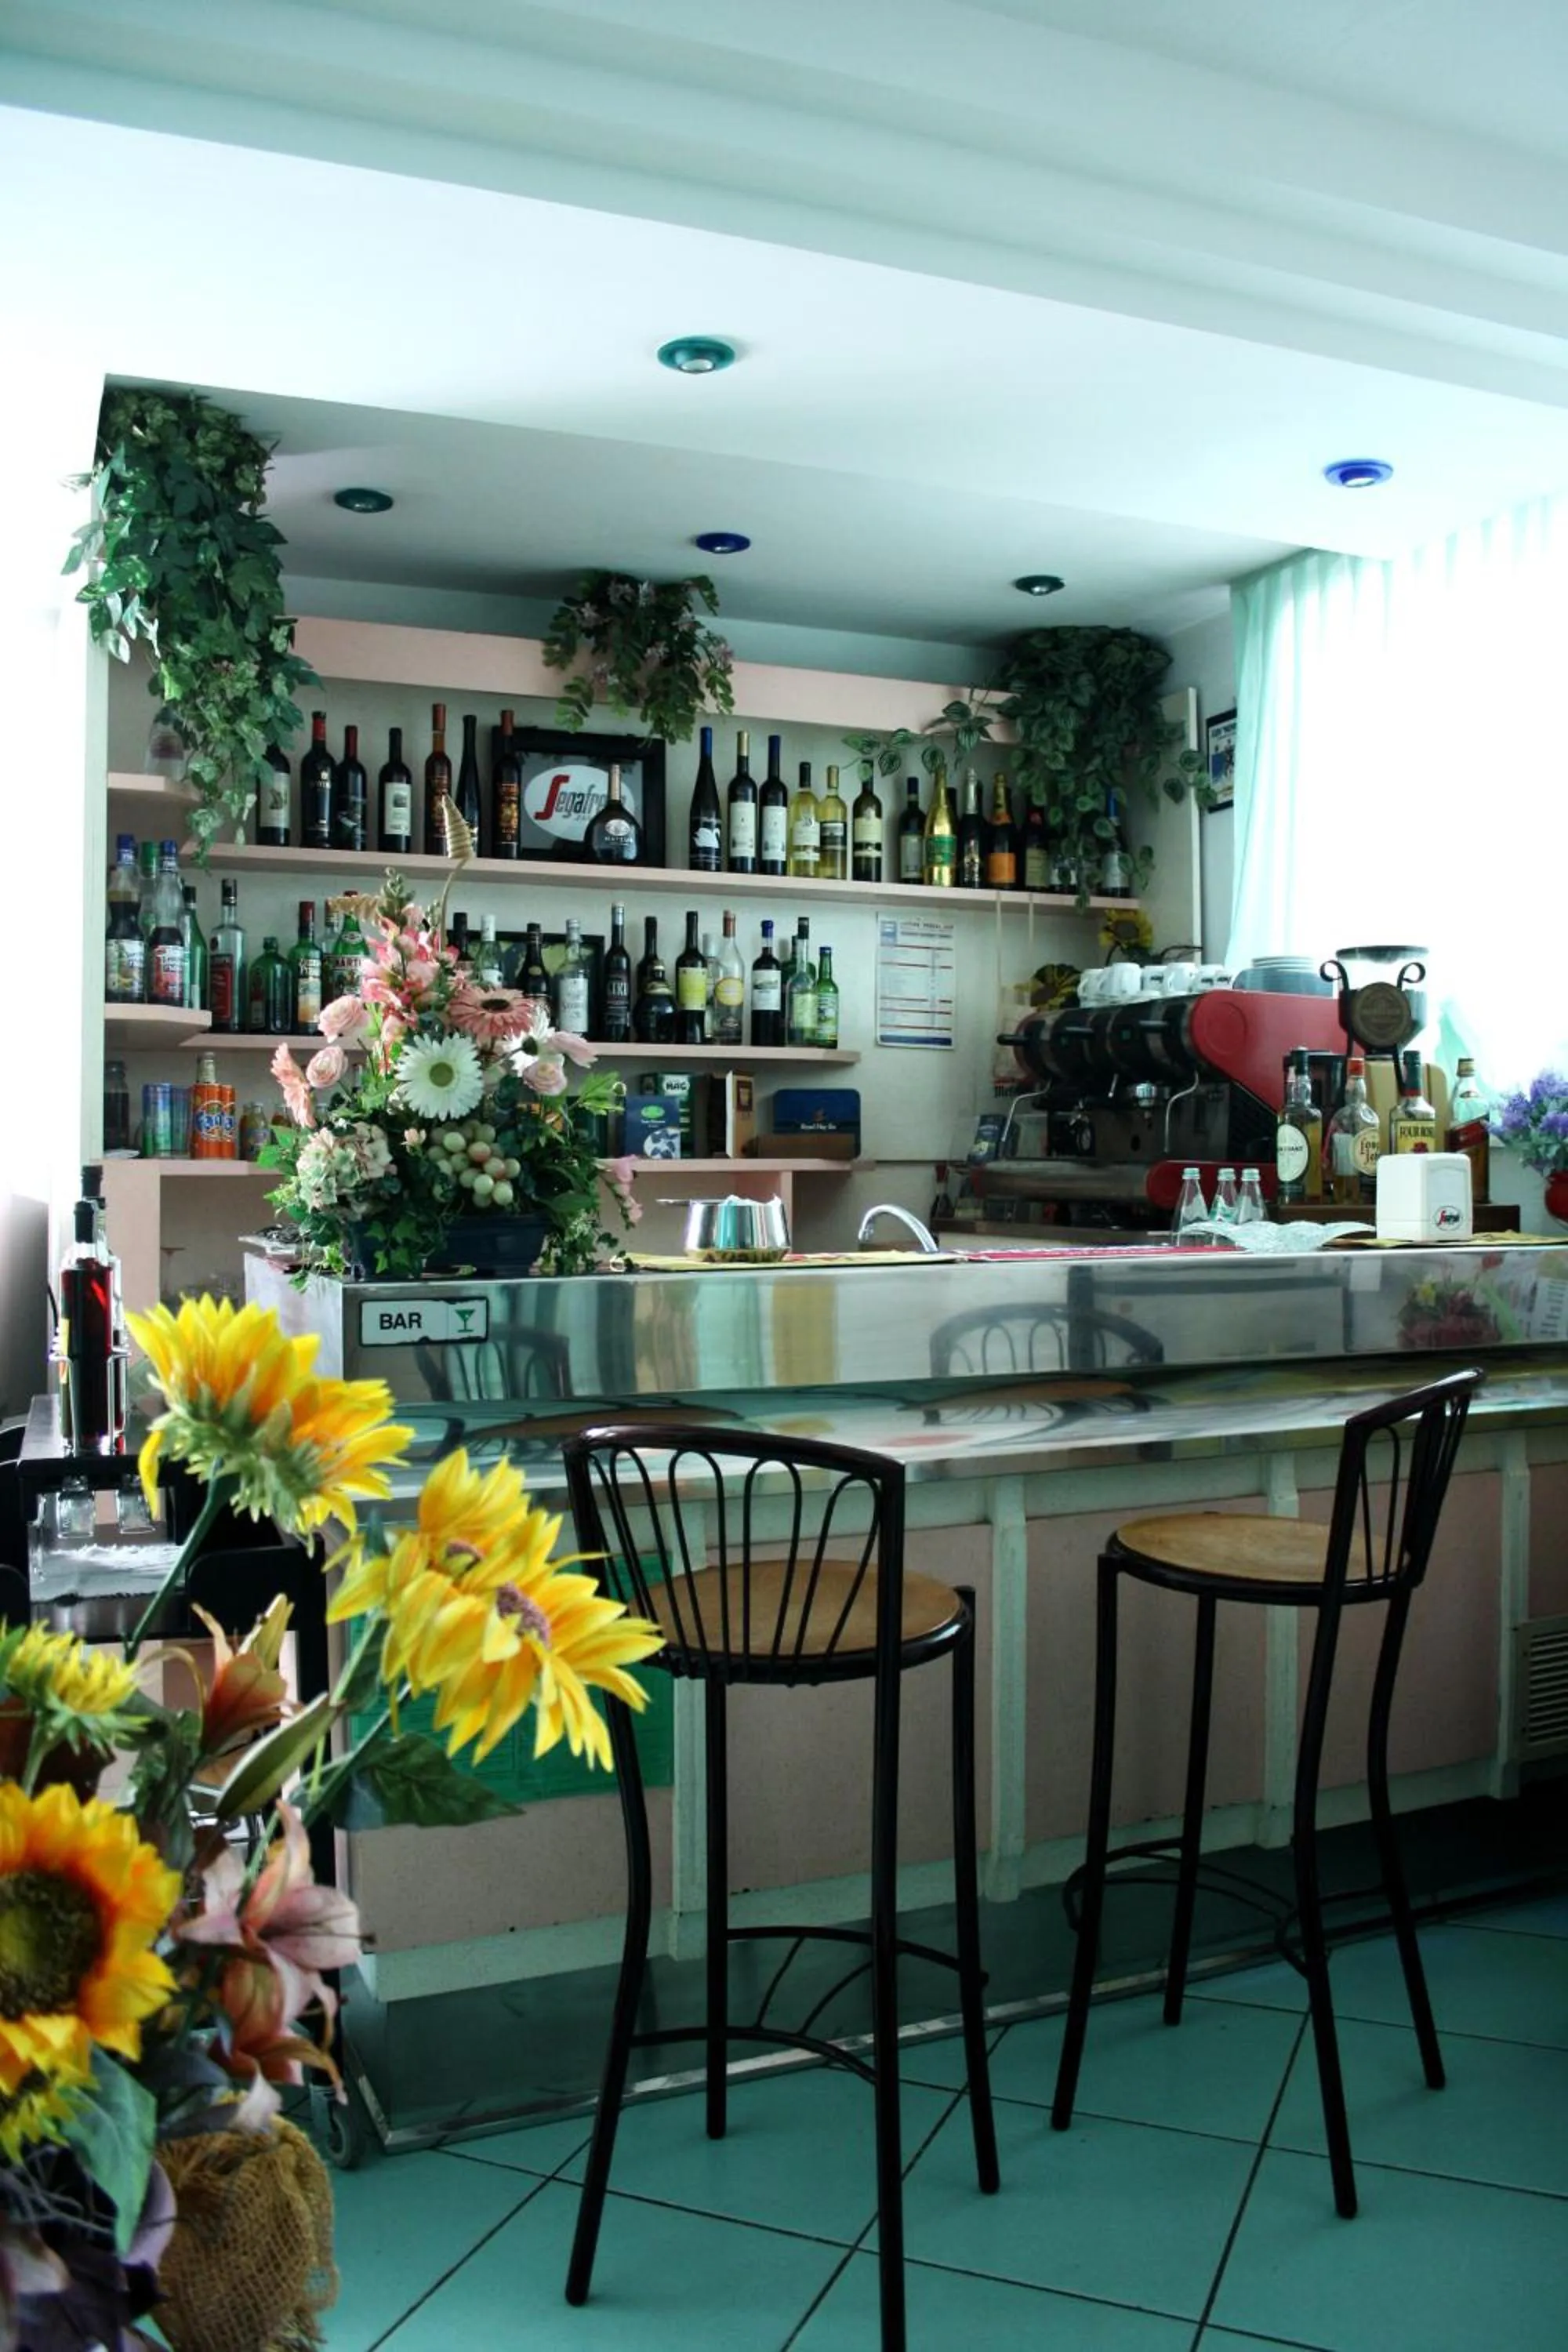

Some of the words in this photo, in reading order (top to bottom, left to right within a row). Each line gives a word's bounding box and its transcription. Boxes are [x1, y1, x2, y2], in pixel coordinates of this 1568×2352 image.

[534, 774, 627, 821] Segafre
[334, 957, 361, 967] MARTI
[1359, 1136, 1379, 1155] Lon
[379, 1312, 422, 1330] BAR
